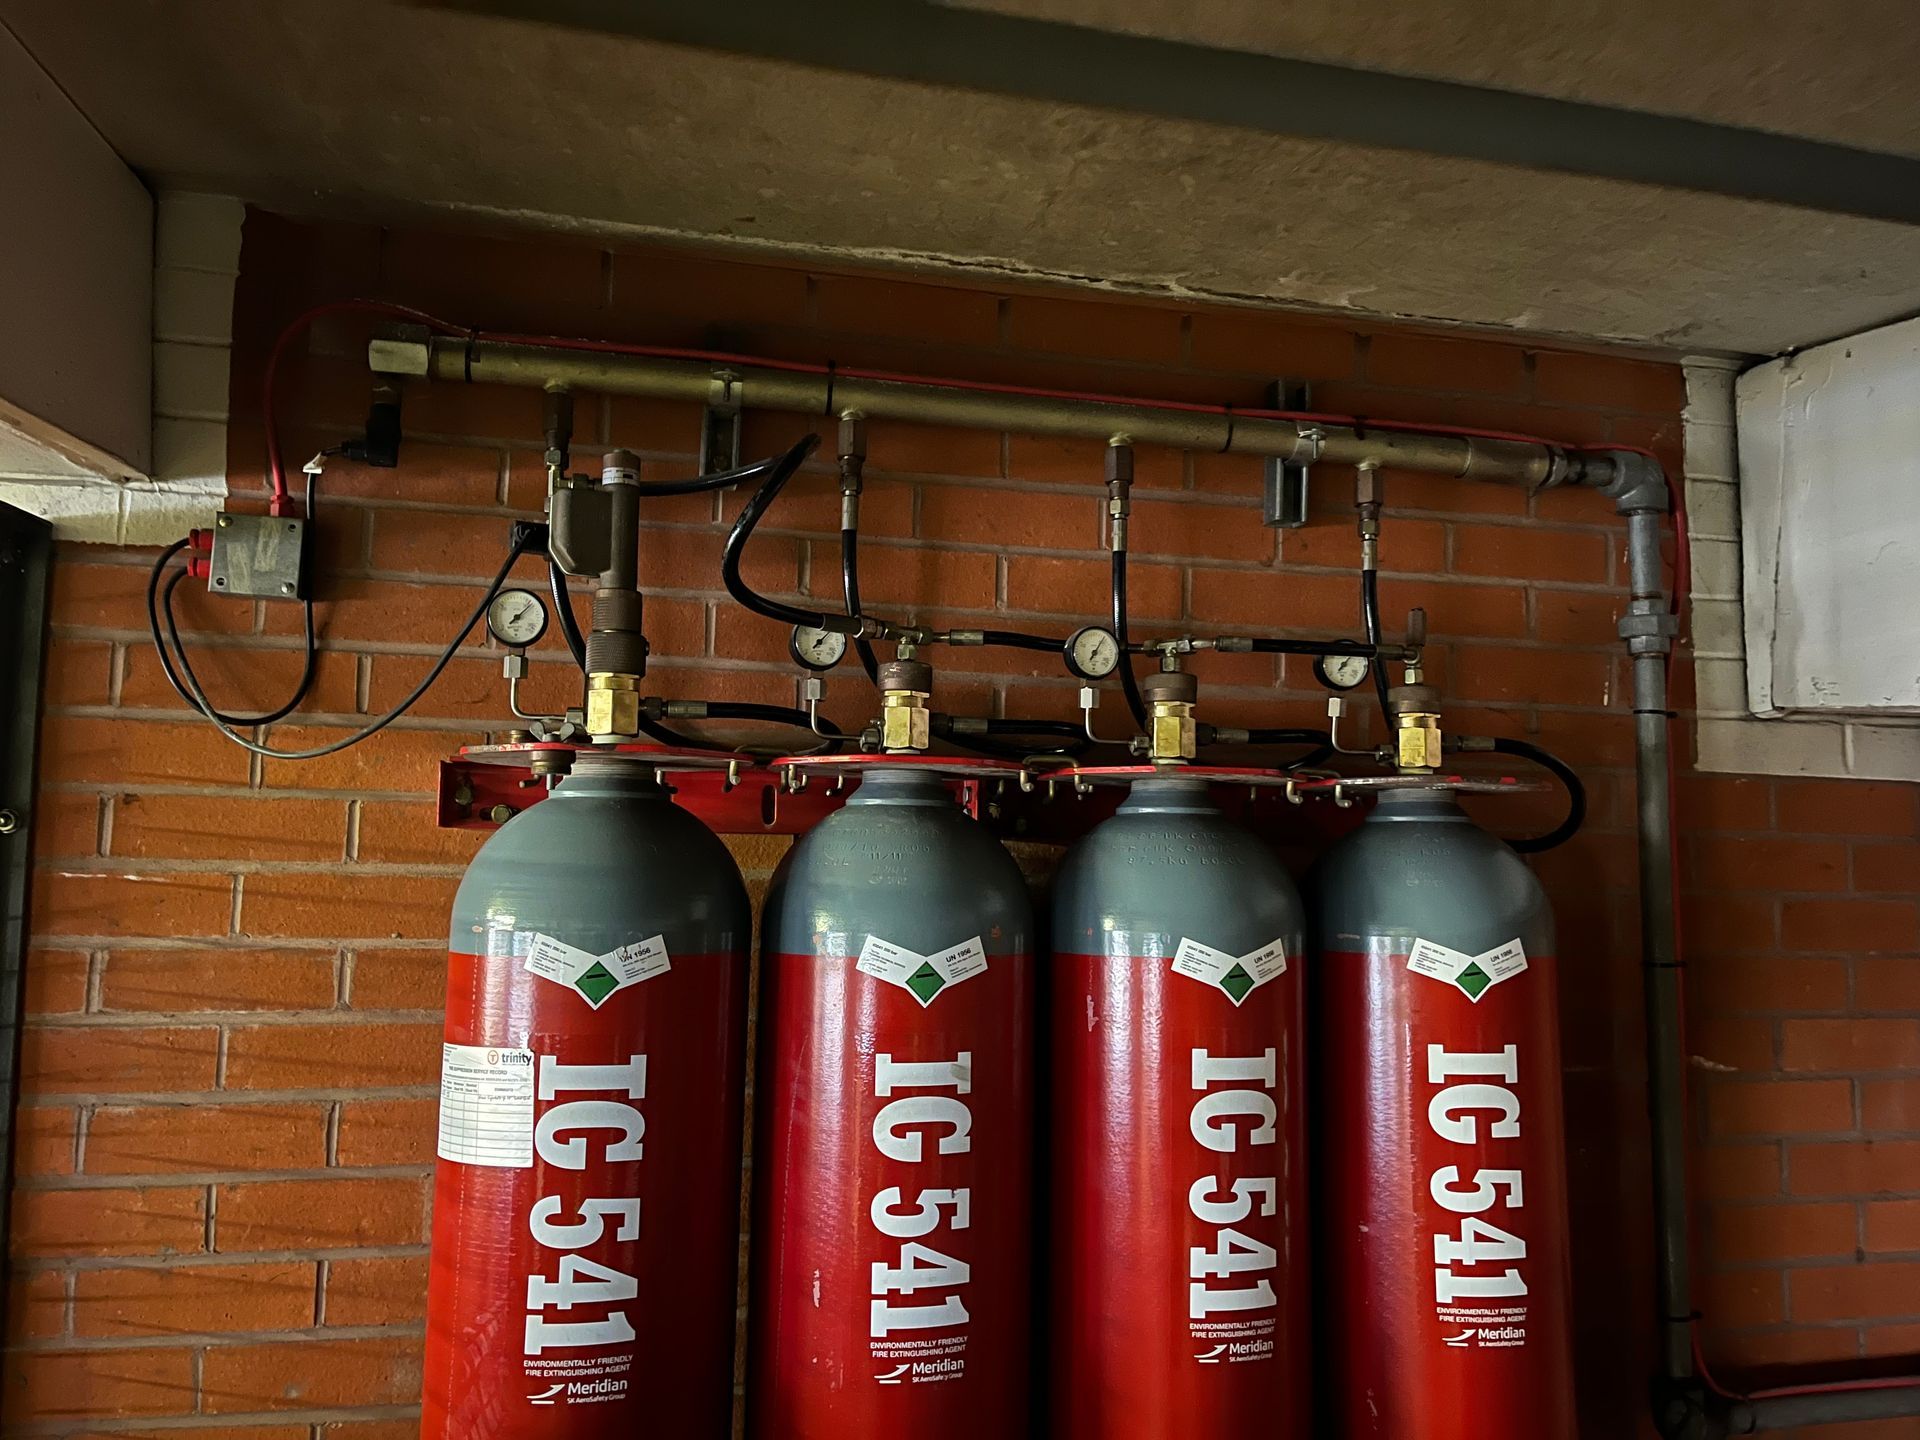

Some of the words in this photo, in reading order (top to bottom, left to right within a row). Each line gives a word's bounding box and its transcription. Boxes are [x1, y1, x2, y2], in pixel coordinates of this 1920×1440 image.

[634, 947, 651, 958] 1956
[946, 955, 957, 963] UN
[1254, 956, 1263, 964] UN
[1490, 955, 1500, 963] UN
[502, 1051, 532, 1066] trinity
[1190, 1048, 1277, 1152] IG
[1427, 1044, 1520, 1144] IG
[535, 1055, 647, 1170] IG
[872, 1051, 972, 1162] IG
[1430, 1165, 1528, 1304] 541
[1189, 1175, 1277, 1319] 541
[870, 1186, 970, 1337] 541
[524, 1195, 640, 1355] 541
[1251, 1318, 1276, 1327] FRIENDLY
[1208, 1330, 1256, 1338] EXTINGUISHING
[1478, 1327, 1525, 1339] Meridian
[870, 1340, 936, 1349] ENVIRONMENTALLY
[938, 1336, 968, 1346] FRIENDLY
[1229, 1339, 1273, 1354] Meridian
[890, 1348, 943, 1358] EXTINGUISHING
[945, 1345, 966, 1354] AGENT
[524, 1359, 596, 1368] ENVIRONMENTALLY
[598, 1354, 633, 1365] FRIENDLY
[913, 1358, 964, 1374] Meridian
[544, 1367, 603, 1377] EXTINGUISHING
[605, 1364, 630, 1373] AGENT
[567, 1379, 627, 1395] Meridian
